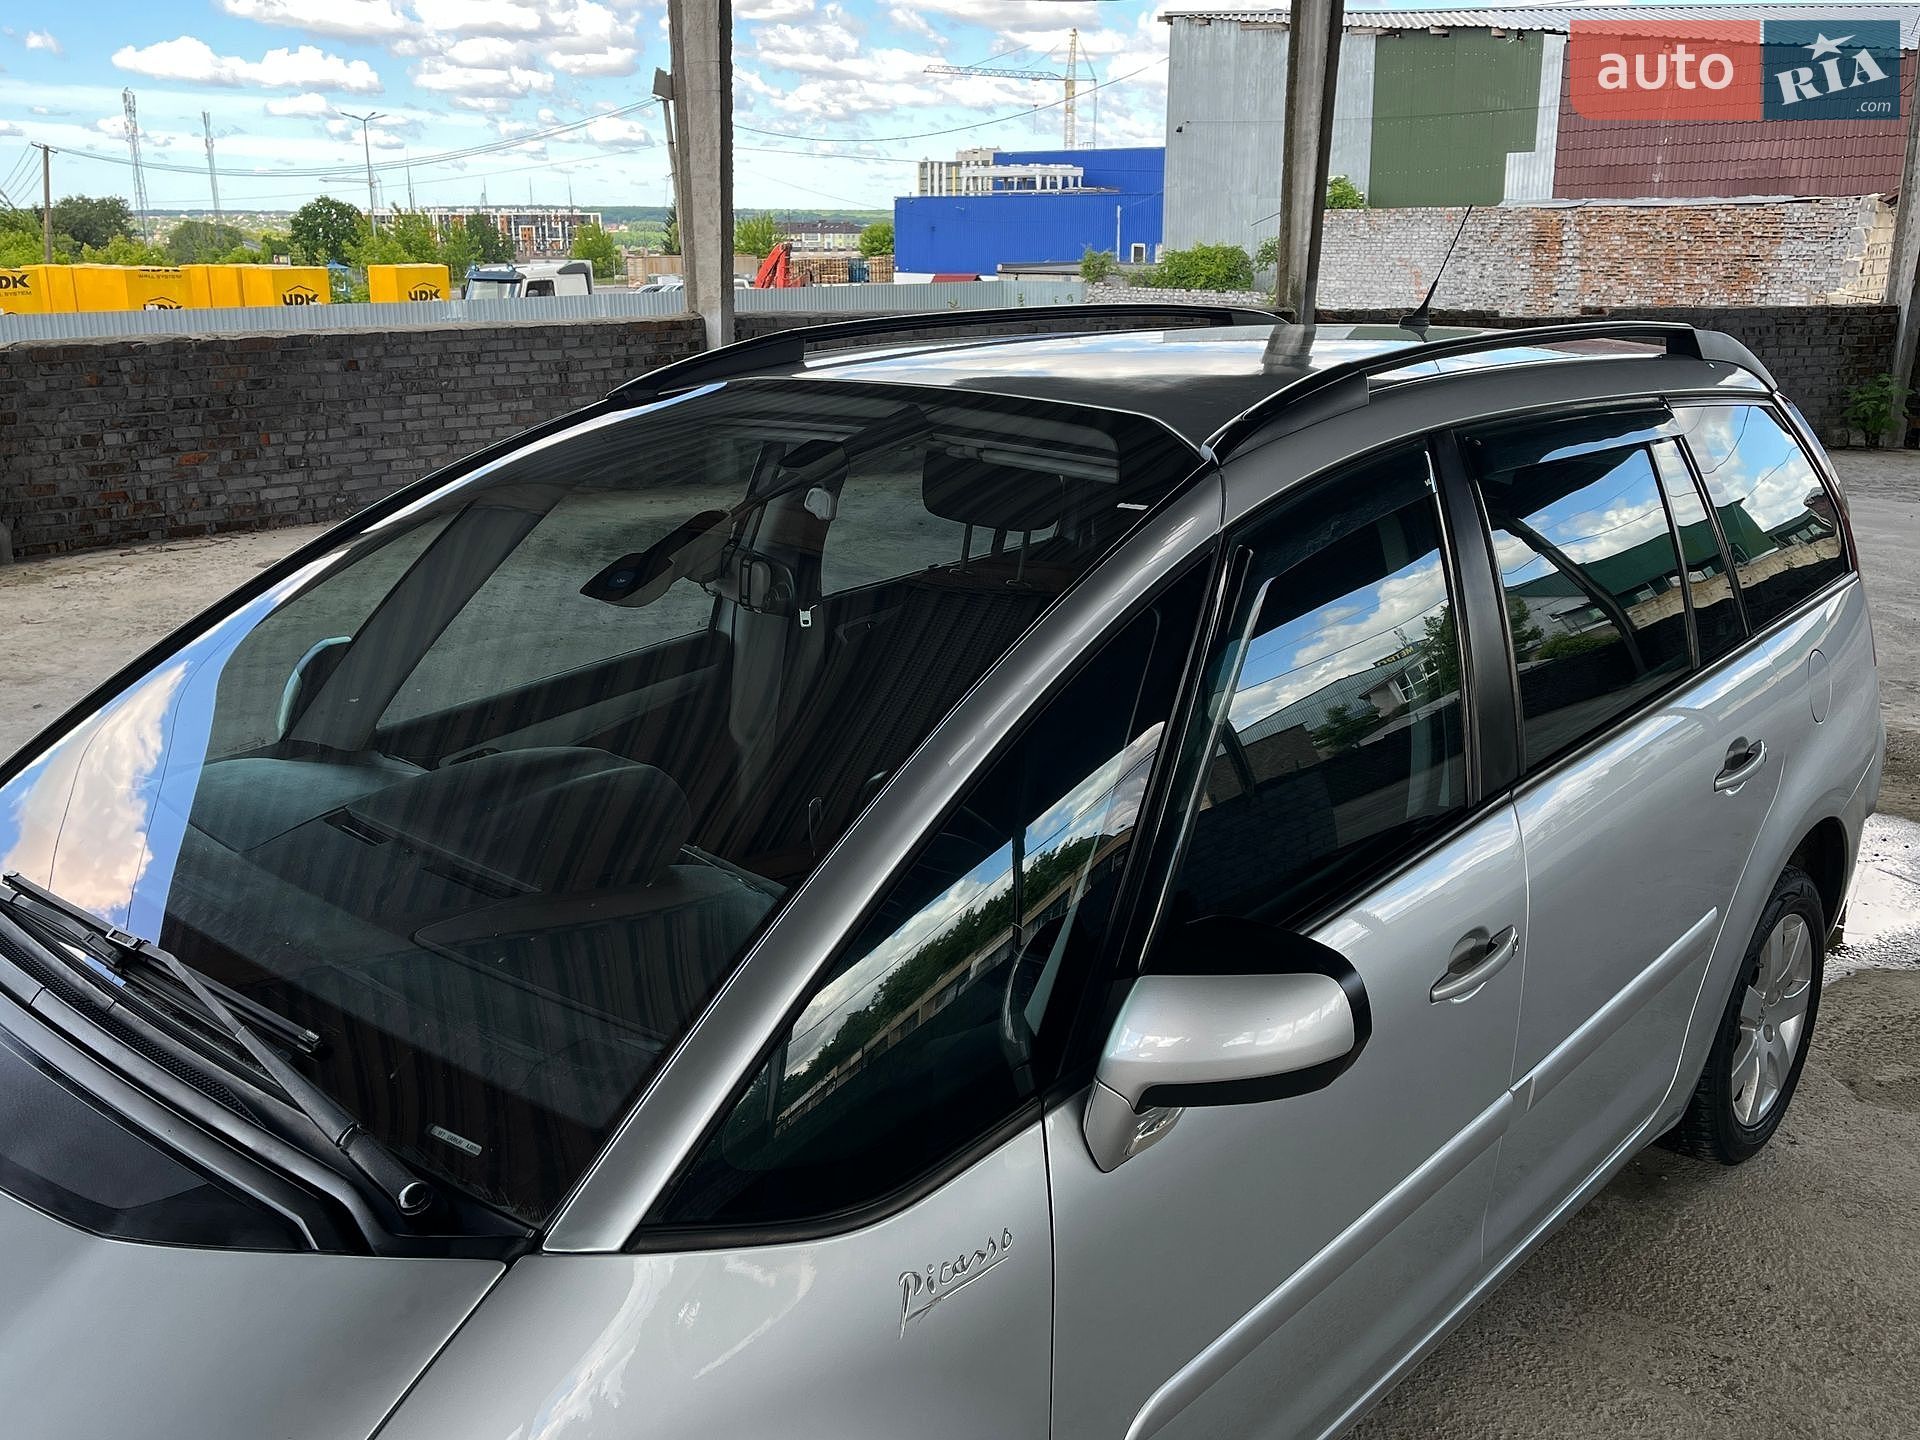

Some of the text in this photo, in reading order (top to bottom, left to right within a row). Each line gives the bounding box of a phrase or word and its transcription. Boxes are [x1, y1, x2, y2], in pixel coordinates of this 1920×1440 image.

[281, 293, 319, 306] UDK
[408, 288, 441, 301] UDK
[898, 1227, 1013, 1341] Picasso
